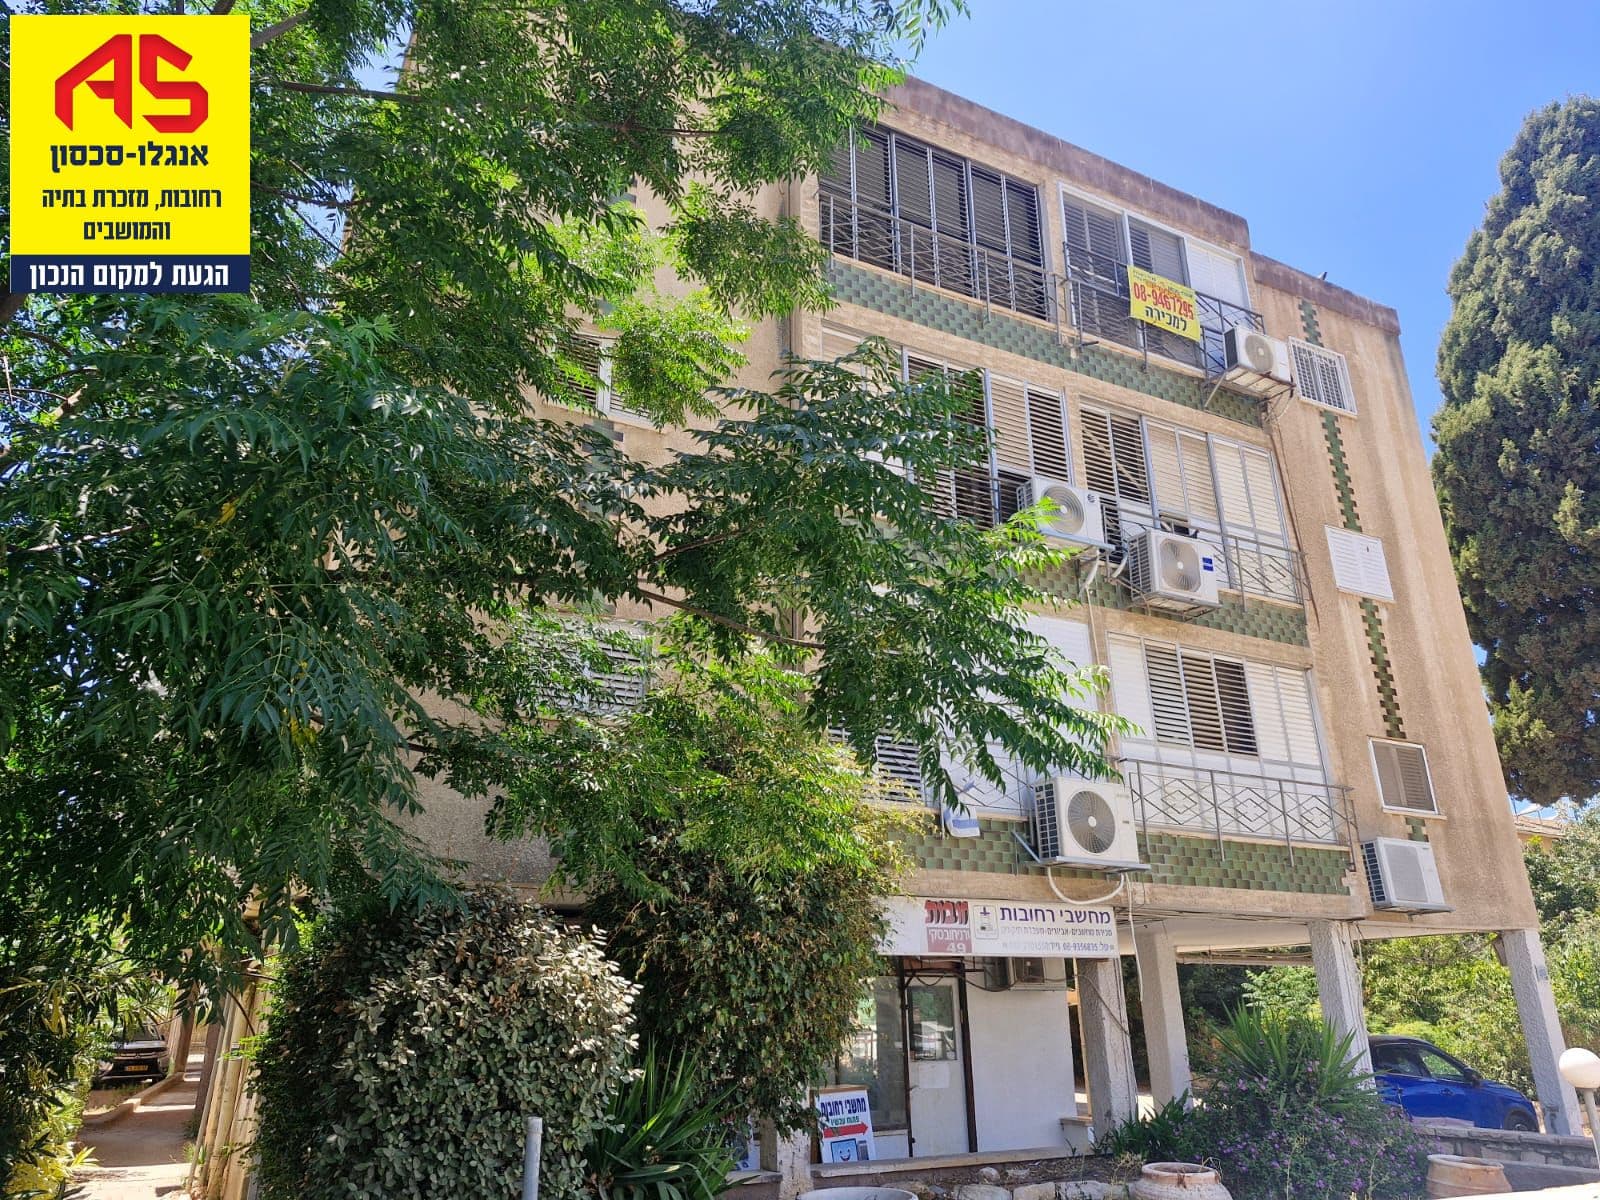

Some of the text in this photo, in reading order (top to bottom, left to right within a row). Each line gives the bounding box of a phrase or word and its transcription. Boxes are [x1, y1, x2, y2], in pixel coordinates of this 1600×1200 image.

[1133, 281, 1194, 321] 08-9467295
[1145, 306, 1187, 331] למכירה
[1000, 907, 1111, 924] מחשבי רחובות
[820, 1098, 866, 1116] מחשבי רחובות
